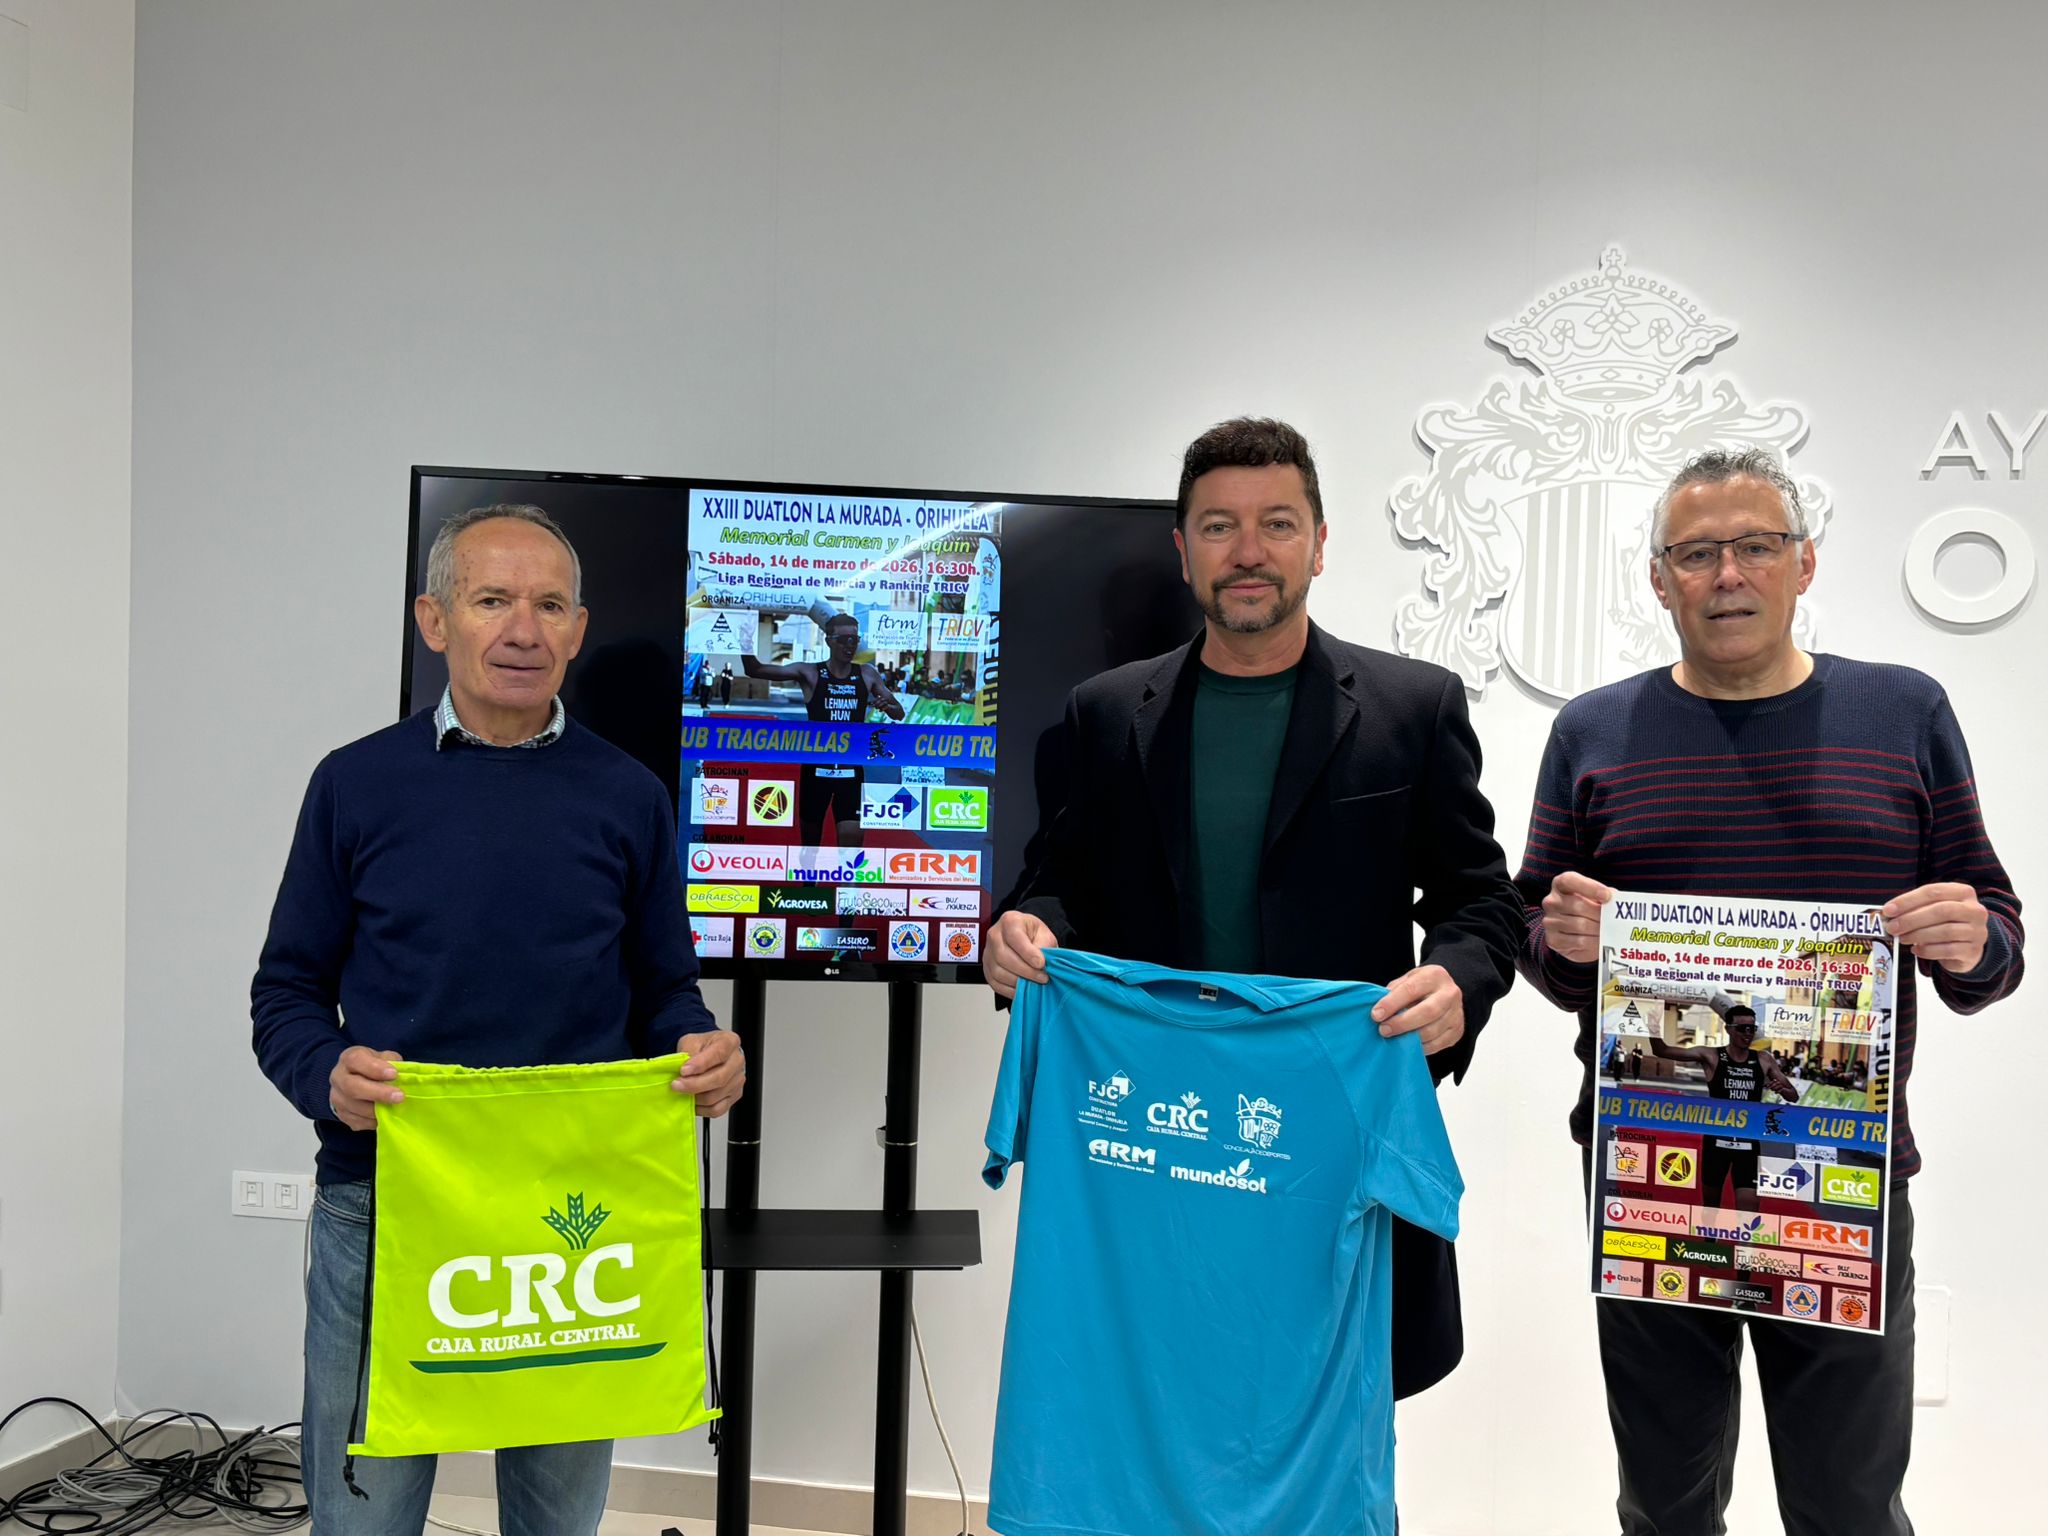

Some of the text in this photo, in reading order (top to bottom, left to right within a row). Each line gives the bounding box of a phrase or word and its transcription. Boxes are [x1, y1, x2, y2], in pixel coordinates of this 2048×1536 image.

[703, 497, 739, 520] XXIII
[744, 499, 812, 524] DUATLON
[817, 502, 836, 525] LA
[839, 503, 903, 528] MURADA
[915, 506, 989, 532] ORIHUELA
[720, 527, 971, 557] Memorial Carmen y Jaquín
[708, 551, 766, 569] Sábado,
[770, 554, 788, 568] 14
[792, 555, 809, 569] de
[812, 558, 857, 571] marzo
[881, 560, 922, 575] 2026,
[927, 562, 981, 576] 16:30h.
[1904, 507, 2036, 625] O
[718, 572, 744, 586] Liga
[747, 573, 802, 588] Regional
[805, 576, 821, 587] de
[869, 580, 877, 592] y
[880, 580, 930, 594] Ranking
[701, 594, 746, 605] ORGANIZA
[938, 617, 985, 638] TRICV
[824, 697, 858, 710] LEHMANN
[830, 710, 851, 721] HUN
[716, 727, 851, 753] TRAGAMILLAS
[915, 733, 964, 757] CLUB
[695, 766, 749, 776] PATROCINAN
[863, 804, 901, 819] FJC
[934, 801, 981, 821] CRC
[718, 856, 784, 871] VEOLIA
[889, 852, 977, 875] ARM
[788, 865, 885, 884] mundosol
[690, 893, 755, 902] OBRAESCOL
[778, 900, 828, 910] AGROVESA
[1615, 901, 1647, 921] XXIII
[1651, 903, 1713, 925] DUATLON
[1718, 907, 1735, 926] LA
[1738, 908, 1798, 930] MURADA
[1810, 911, 1882, 935] ORIHUELA
[703, 934, 731, 943] Cruz Roja
[1630, 926, 1865, 956] Memorial Carmen y Joaquín
[1620, 947, 1873, 976] Sábado, 14 de marzo de 2026, 16:30h.
[1628, 966, 1652, 978] Liga
[1655, 968, 1704, 982] Regional
[1706, 971, 1721, 982] de
[1723, 972, 1763, 984] Murcia
[1766, 976, 1773, 986] y
[1776, 976, 1824, 990] Ranking
[1614, 984, 1653, 994] ORGANIZA
[1088, 1079, 1119, 1100] FJC
[1723, 1077, 1755, 1090] LEHMANN
[1729, 1089, 1749, 1100] HUN
[1090, 1105, 1116, 1117] DUATLON
[1147, 1102, 1209, 1133] CRC
[1628, 1098, 1749, 1129] TRAGAMILLAS
[1146, 1125, 1208, 1141] CAJA RURAL CENTRAL
[1808, 1116, 1856, 1139] CLUB
[1089, 1139, 1156, 1165] ARM
[1170, 1165, 1267, 1194] mundosol
[1759, 1174, 1795, 1190] FJC
[1827, 1178, 1873, 1199] CRC
[1629, 1208, 1688, 1226] VEOLIA
[1691, 1224, 1777, 1245] mundosol
[1784, 1220, 1869, 1247] ARM
[1605, 1238, 1662, 1251] OBRAESCOL
[1682, 1252, 1728, 1264] AGROVESA
[427, 1242, 641, 1329] CRC
[426, 1323, 641, 1354] CAJA RURAL CENTRAL
